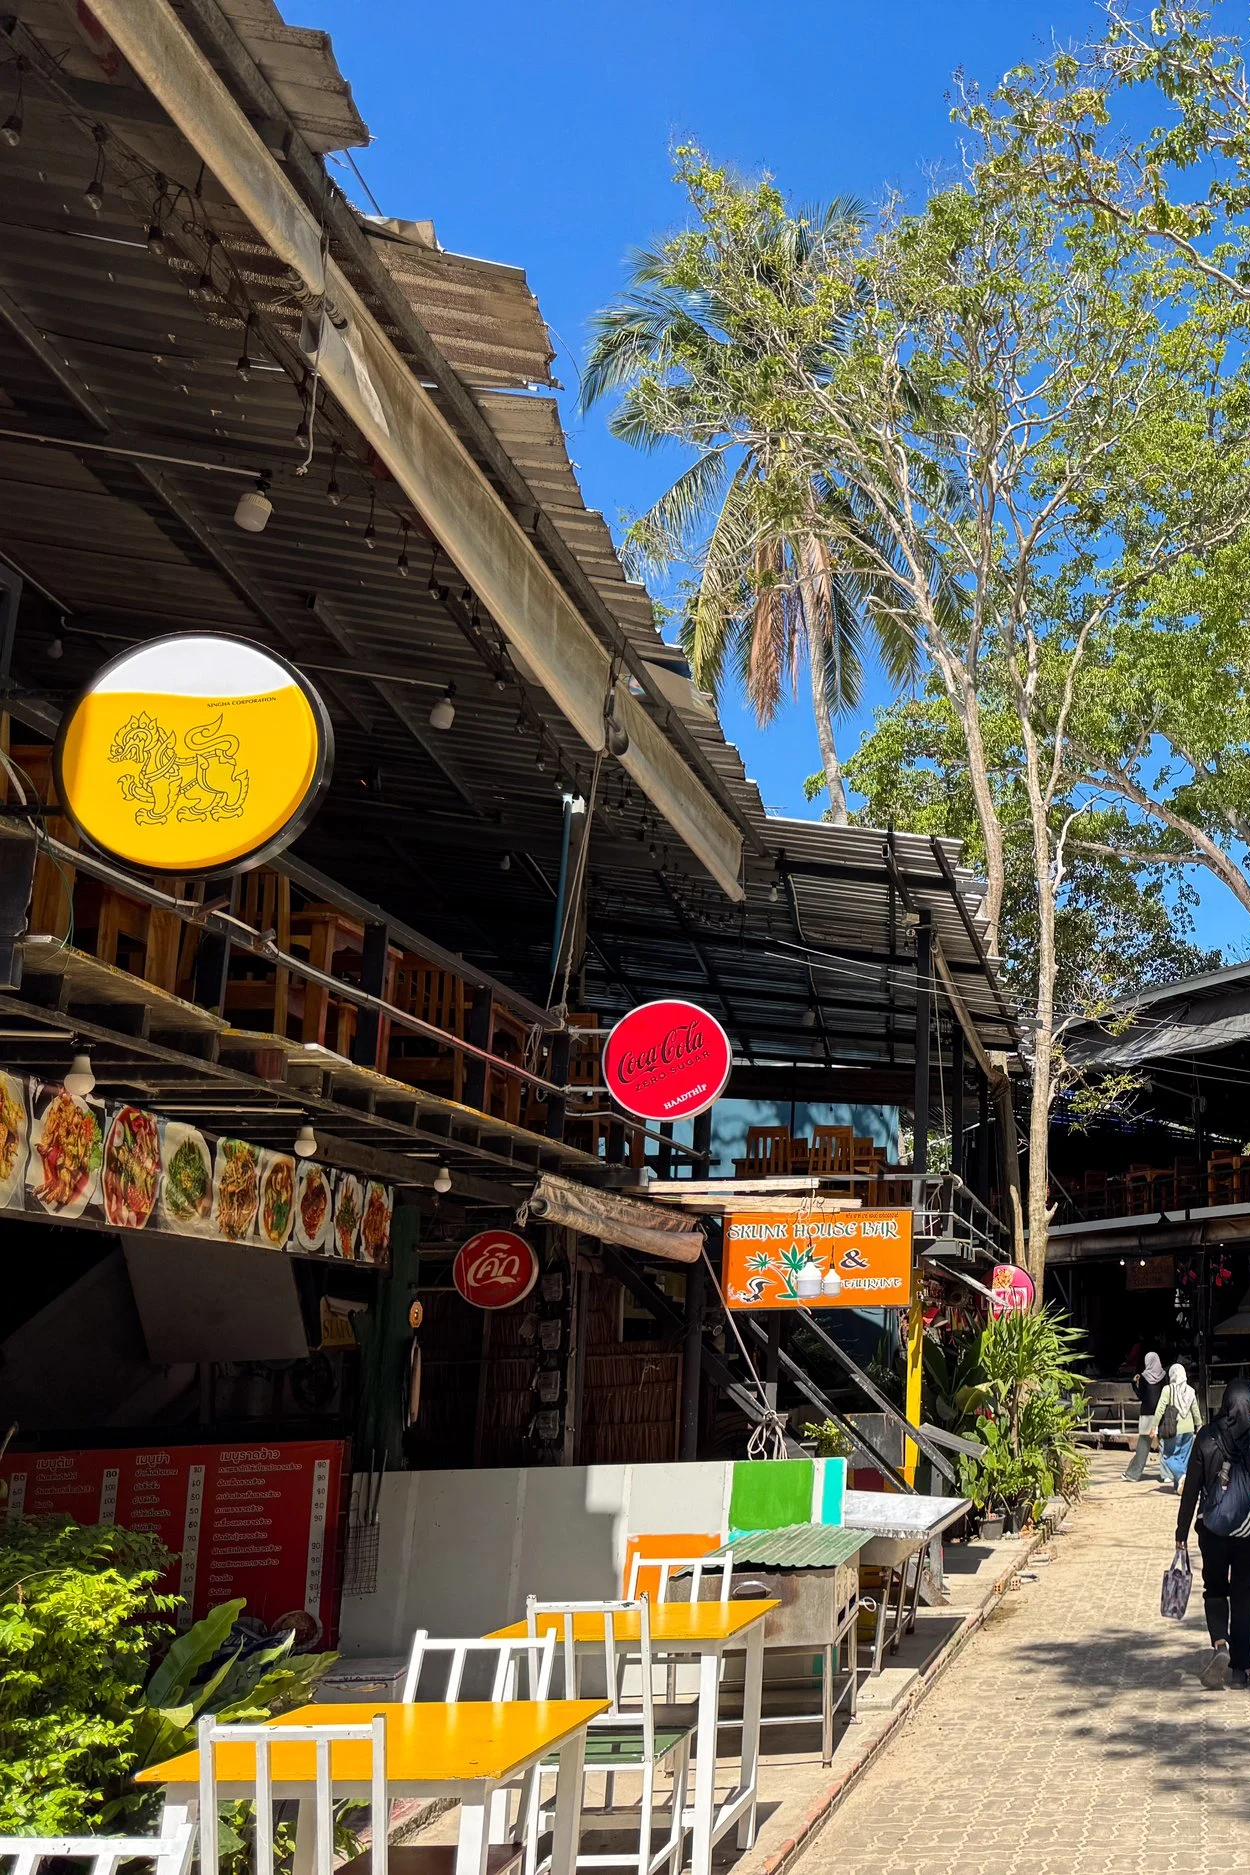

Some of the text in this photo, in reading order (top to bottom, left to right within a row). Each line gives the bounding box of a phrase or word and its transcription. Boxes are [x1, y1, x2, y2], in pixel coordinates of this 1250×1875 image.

[232, 696, 277, 706] CORPORATION
[635, 1051, 710, 1092] ZERO SUGAR
[663, 1083, 708, 1110] HAADTHIP
[727, 1219, 901, 1241] SKUNK HOUSE BAR
[839, 1248, 869, 1270] &
[841, 1276, 902, 1290] TAURANT
[219, 1447, 281, 1465] เมนูราดข้าว
[105, 1470, 117, 1478] 80
